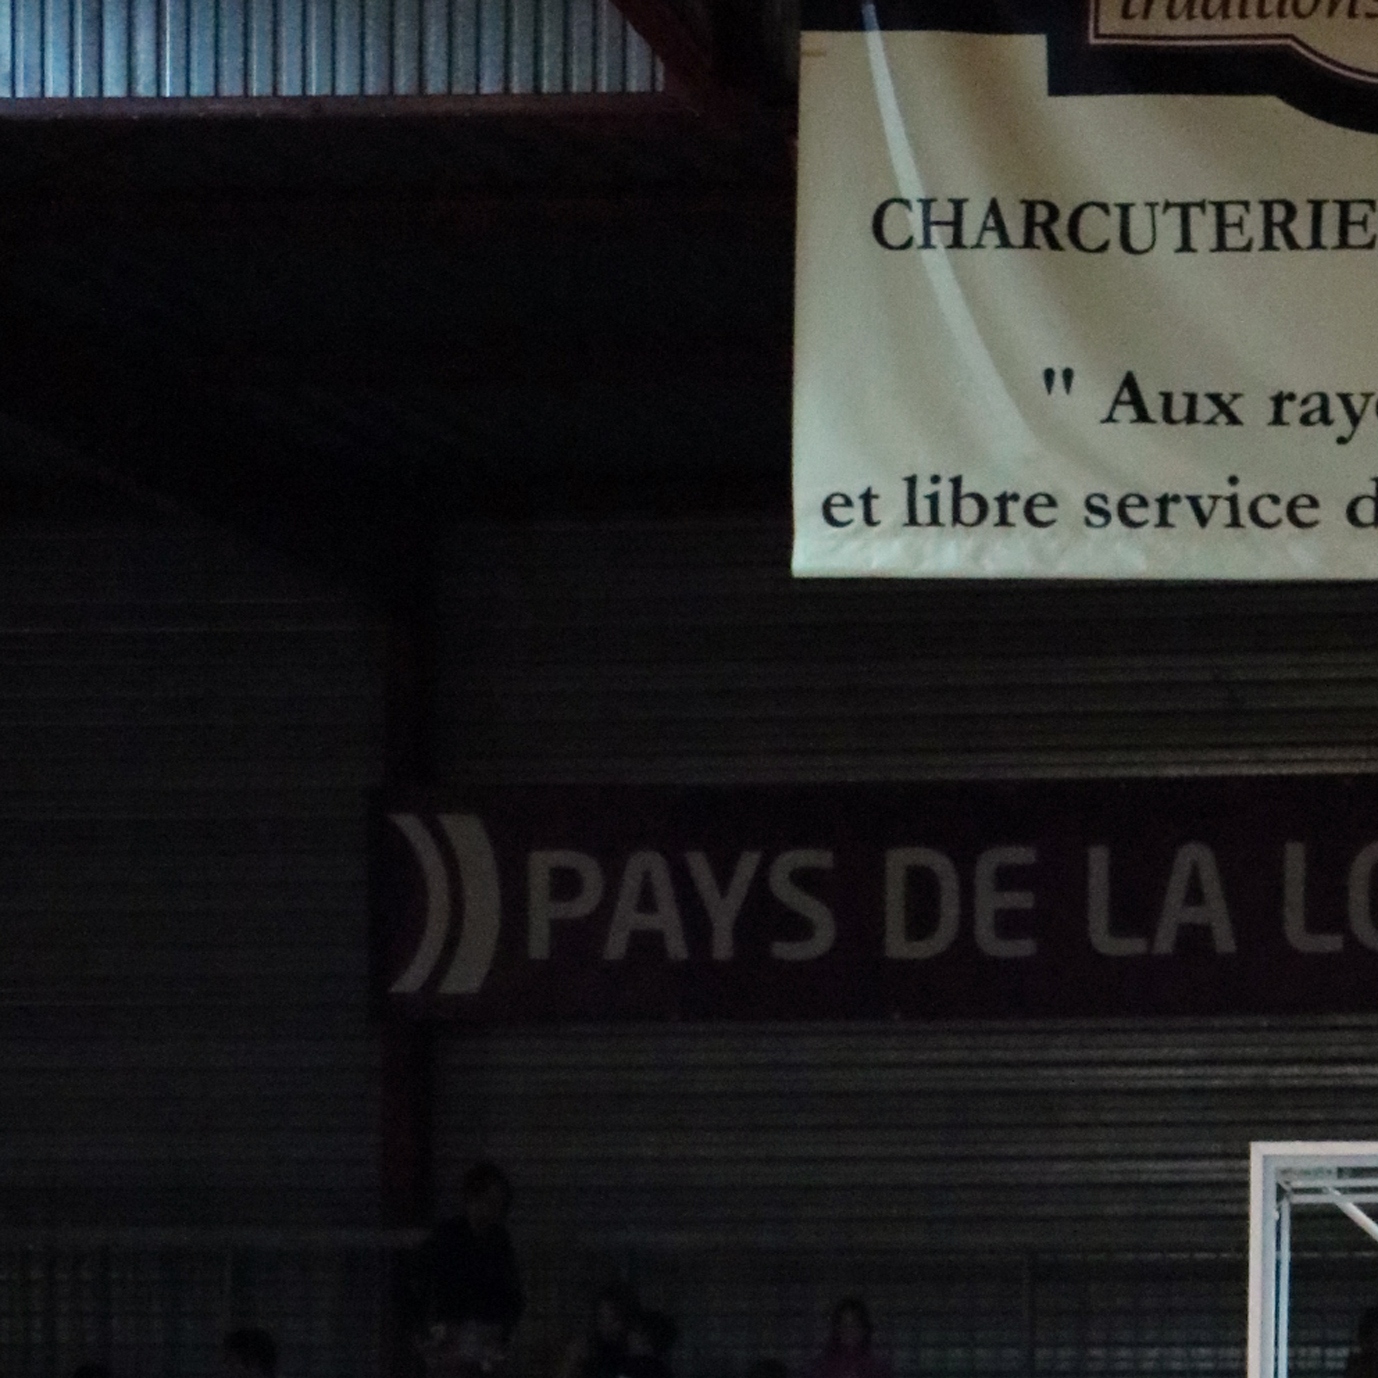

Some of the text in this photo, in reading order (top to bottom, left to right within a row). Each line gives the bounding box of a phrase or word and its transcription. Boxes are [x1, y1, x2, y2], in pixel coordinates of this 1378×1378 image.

[1101, 371, 1243, 427] Aux
[820, 481, 882, 531] et
[902, 473, 1060, 530] libre
[1083, 470, 1322, 531] service
[525, 846, 838, 961] PAYS
[884, 845, 1037, 960] DE
[1086, 840, 1238, 956] LA
